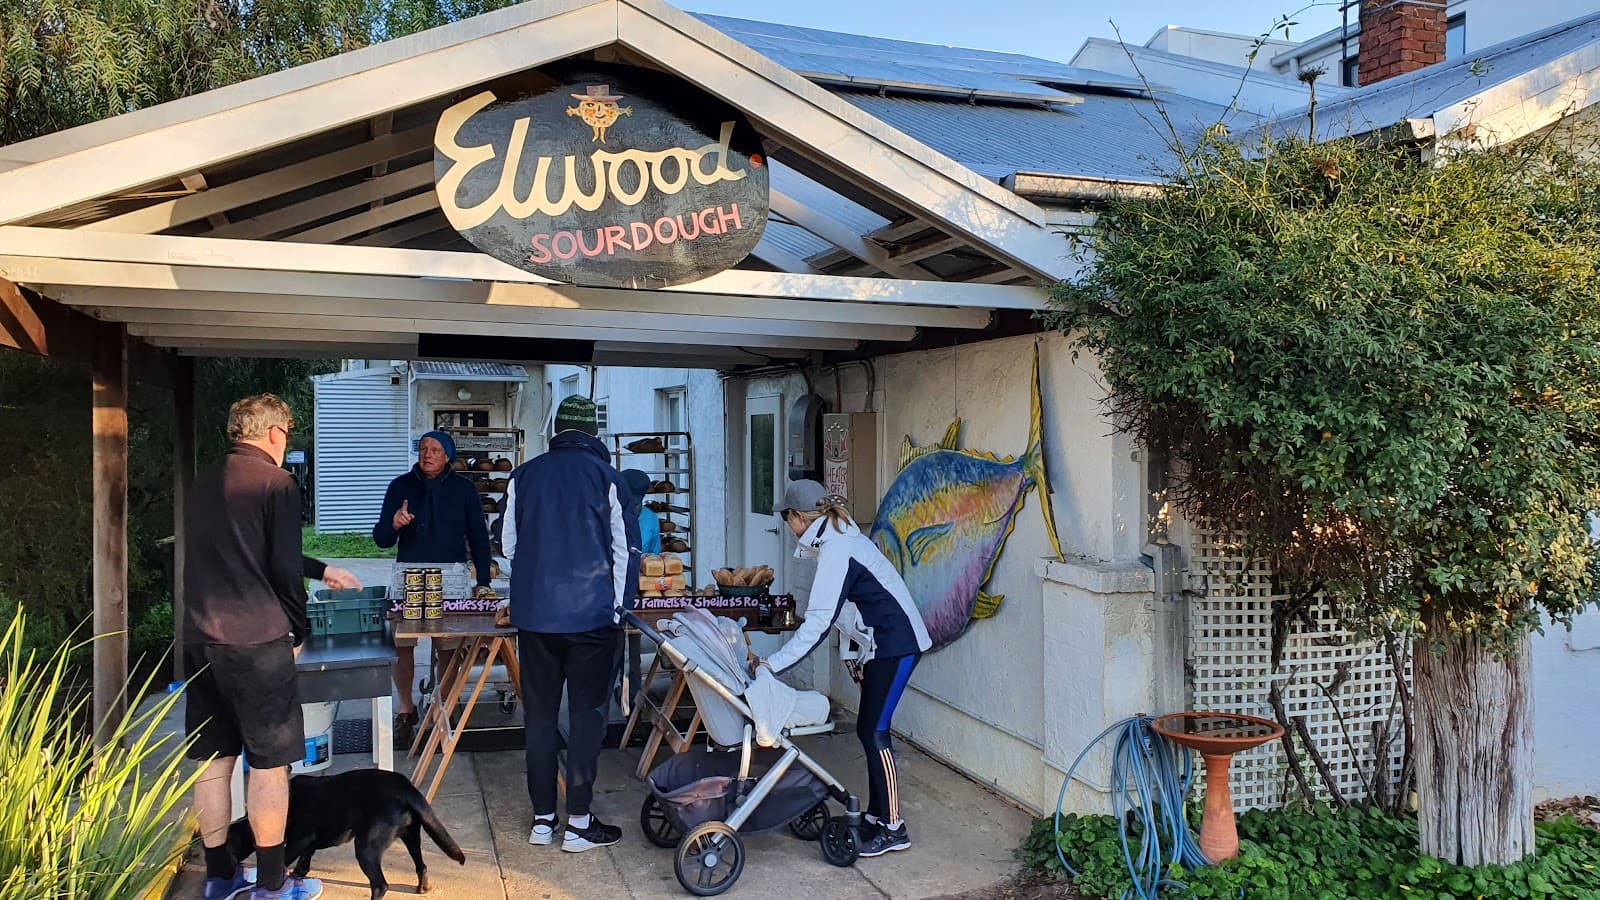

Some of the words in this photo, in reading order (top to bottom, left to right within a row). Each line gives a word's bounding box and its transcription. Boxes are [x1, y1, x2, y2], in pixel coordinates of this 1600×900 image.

[434, 90, 747, 231] Elwood
[529, 203, 742, 264] SOURDOUGH
[743, 597, 760, 608] Ro
